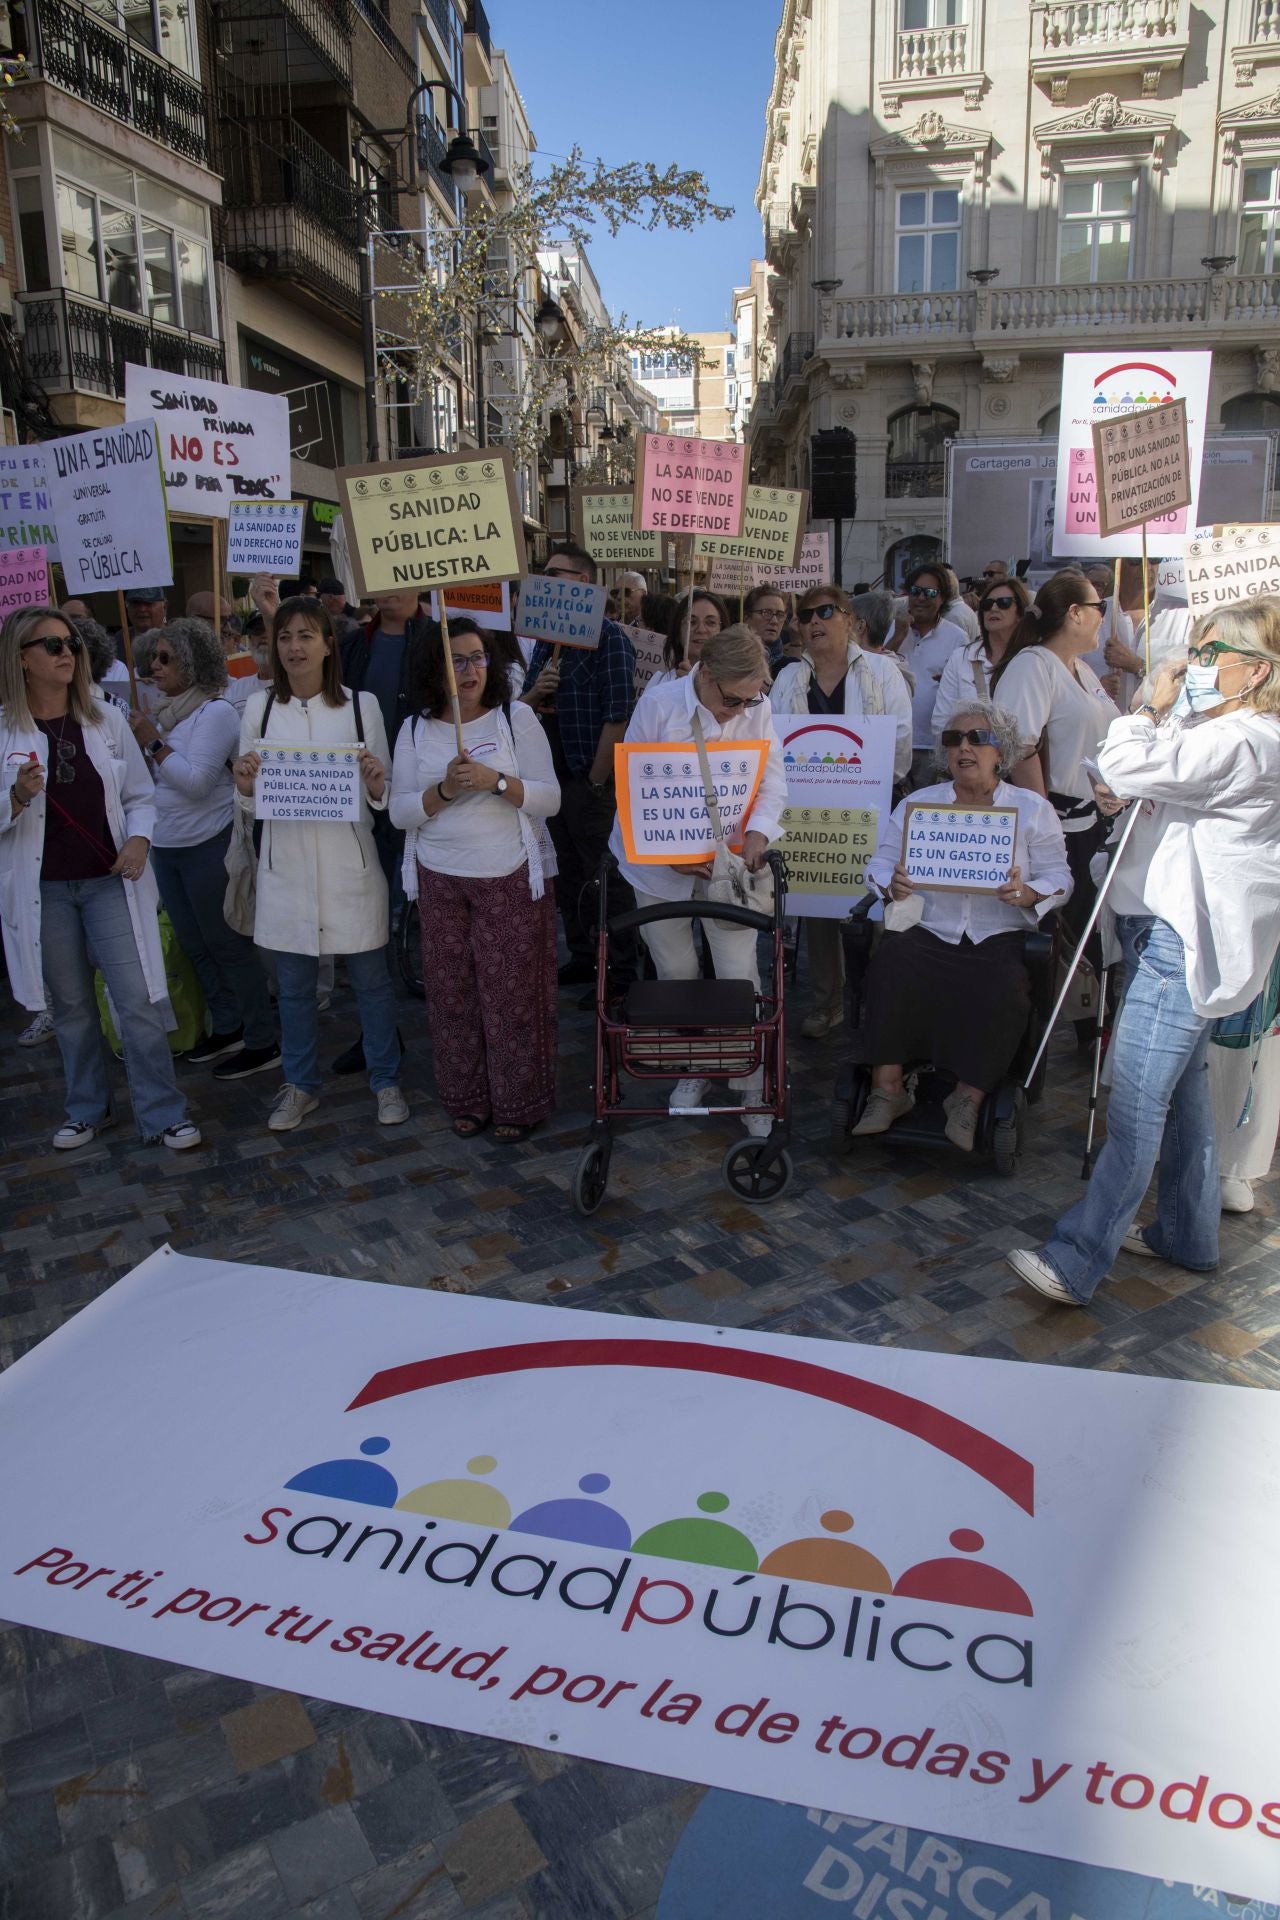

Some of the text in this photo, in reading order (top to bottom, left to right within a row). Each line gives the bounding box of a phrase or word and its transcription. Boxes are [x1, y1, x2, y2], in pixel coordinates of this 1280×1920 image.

[263, 361, 280, 377] VERSUS
[170, 434, 239, 466] NO ES
[1108, 433, 1181, 466] POR UNA SANIDAD
[53, 443, 90, 478] UNA
[970, 457, 1031, 470] Cartagena
[1041, 457, 1058, 469] Ja
[1111, 453, 1180, 485] PÚBLICA. NO A LA
[656, 463, 733, 484] LA SANIDAD
[1077, 473, 1094, 484] LA
[1111, 470, 1182, 504] PRIVATIZACIÓN DE
[0, 491, 52, 511] TEN
[651, 488, 734, 507] NO SE VENDE
[1121, 504, 1138, 520] LOS
[1139, 490, 1176, 515] SERVICIOS
[390, 492, 481, 521] SANIDAD
[745, 507, 788, 523] NIDAD
[234, 522, 296, 534] LA SANIDAD ES
[591, 514, 603, 525] LA
[652, 512, 731, 530] SE DEFIENDE
[230, 537, 299, 549] UN DERECHO NO
[371, 521, 501, 554] PÚBLICA: LA
[590, 530, 655, 541] NO SE VENDE
[745, 526, 789, 543] VENDE
[232, 553, 293, 565] UN PRIVILEGIO
[592, 548, 655, 558] SE DEFIENDE
[701, 541, 784, 561] SE DEFIENDE
[800, 549, 820, 559] DAD
[79, 548, 143, 582] PÚBLICA
[392, 554, 491, 583] NUESTRA
[757, 565, 772, 575] NO
[774, 565, 786, 575] SE
[1189, 555, 1280, 582] LA SANIDA
[0, 570, 46, 587] DAD NO
[0, 589, 47, 606] ASTO ES
[444, 591, 456, 602] NA
[1191, 579, 1280, 605] ES UN GAS
[636, 649, 661, 664] DAD
[261, 768, 354, 779] POR UNA SANIDAD
[785, 763, 862, 774] anidadpública
[264, 780, 352, 792] PÚBLICA. NO A LA
[641, 787, 659, 799] LA
[732, 783, 747, 797] NO
[262, 794, 353, 805] PRIVATIZACIÓN DE
[273, 808, 344, 818] LOS SERVICIOS
[643, 804, 743, 820] ES UN GATO ES
[644, 829, 675, 842] UNA
[786, 831, 868, 845] SANIDAD ES
[910, 829, 1011, 846] LA SANIDAD NO
[783, 850, 846, 865] DERECHO
[909, 847, 1010, 864] ES UN GASTO ES
[787, 870, 864, 885] PRIVILEGIO
[907, 865, 1009, 882] UNA INVERSIÓN
[243, 1507, 1034, 1688] sanidadpública
[13, 1547, 111, 1586] Por
[107, 1571, 163, 1610] ti,
[151, 1587, 268, 1628] por
[265, 1605, 333, 1645] tu
[331, 1623, 508, 1691] salud,
[509, 1664, 638, 1709] por
[640, 1679, 702, 1725] la
[714, 1698, 800, 1744] de
[814, 1714, 1011, 1785] todas
[1019, 1758, 1072, 1804] y
[802, 1844, 948, 1920] DIS
